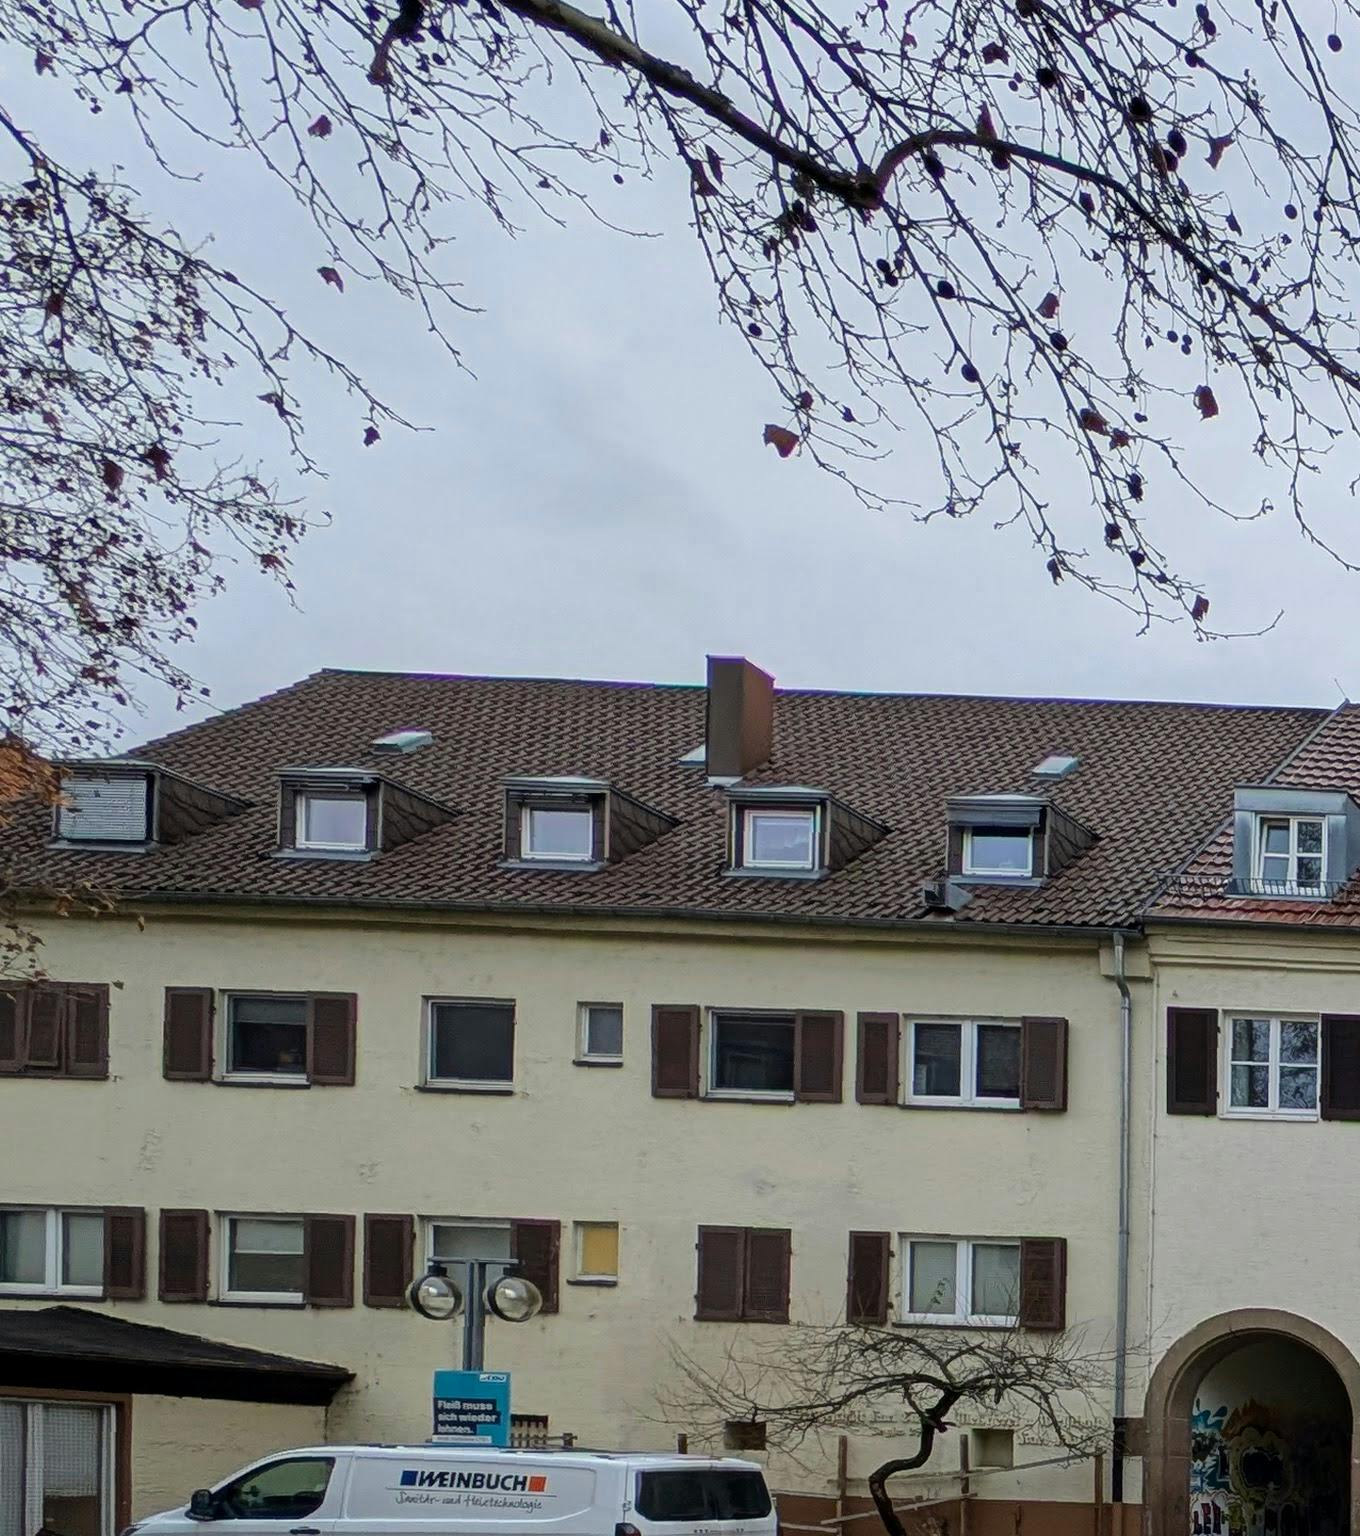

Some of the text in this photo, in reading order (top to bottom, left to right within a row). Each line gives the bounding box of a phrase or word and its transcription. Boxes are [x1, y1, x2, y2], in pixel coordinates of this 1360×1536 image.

[438, 1413, 498, 1422] sich wieder
[418, 1470, 528, 1492] WEINBUCH
[442, 1497, 461, 1505] und
